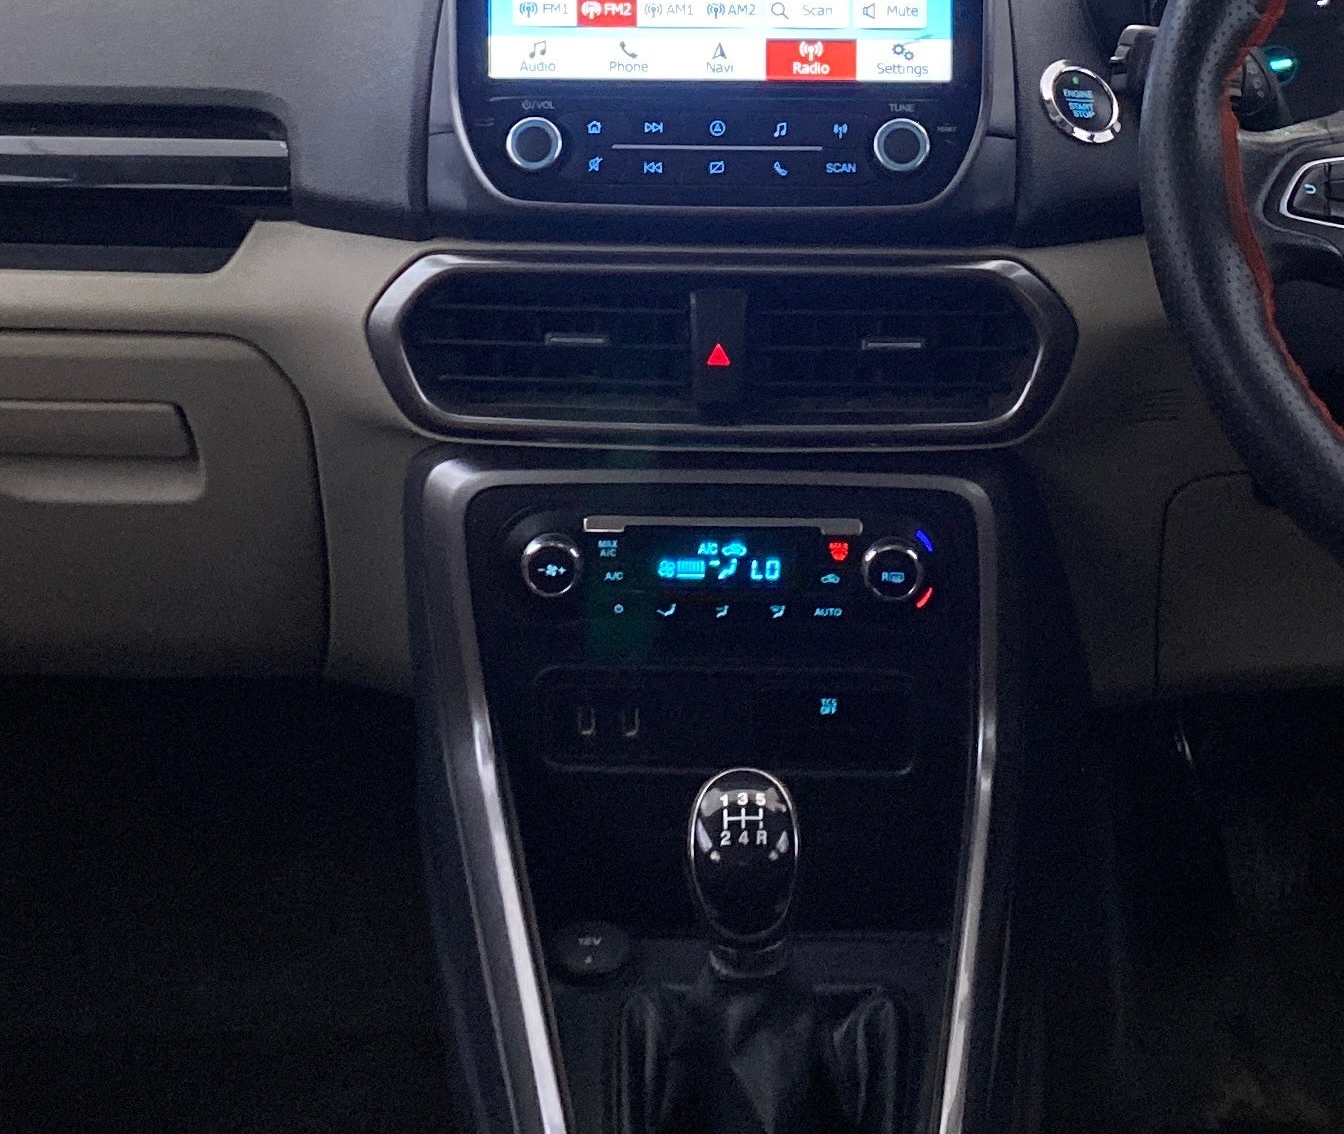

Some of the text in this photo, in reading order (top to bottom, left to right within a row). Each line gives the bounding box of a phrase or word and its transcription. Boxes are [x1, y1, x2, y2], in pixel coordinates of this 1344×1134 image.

[543, 4, 568, 15] FM1
[604, 3, 632, 16] FM2
[667, 4, 693, 15] AM1
[728, 4, 756, 15] AM2
[802, 5, 833, 16] Scan
[887, 5, 918, 17] Mute
[520, 61, 556, 72] Audio
[609, 61, 648, 73] Phone
[706, 61, 734, 73] Navi
[792, 62, 830, 74] Radio
[876, 63, 928, 77] Settings
[1063, 89, 1095, 98] ENGINE
[889, 103, 916, 112] TUNE
[1068, 102, 1094, 111] START
[1073, 109, 1096, 118] STOP
[826, 162, 856, 173] SCAN
[599, 548, 617, 557] A/C
[697, 542, 718, 555] A/C
[751, 559, 781, 580] LO
[605, 571, 624, 581] A/C
[814, 607, 843, 617] AUTO
[720, 793, 728, 807] 1
[737, 792, 748, 806] 3
[756, 792, 766, 806] 5
[720, 831, 731, 846] 2
[738, 831, 749, 845] 4
[756, 830, 767, 845] R
